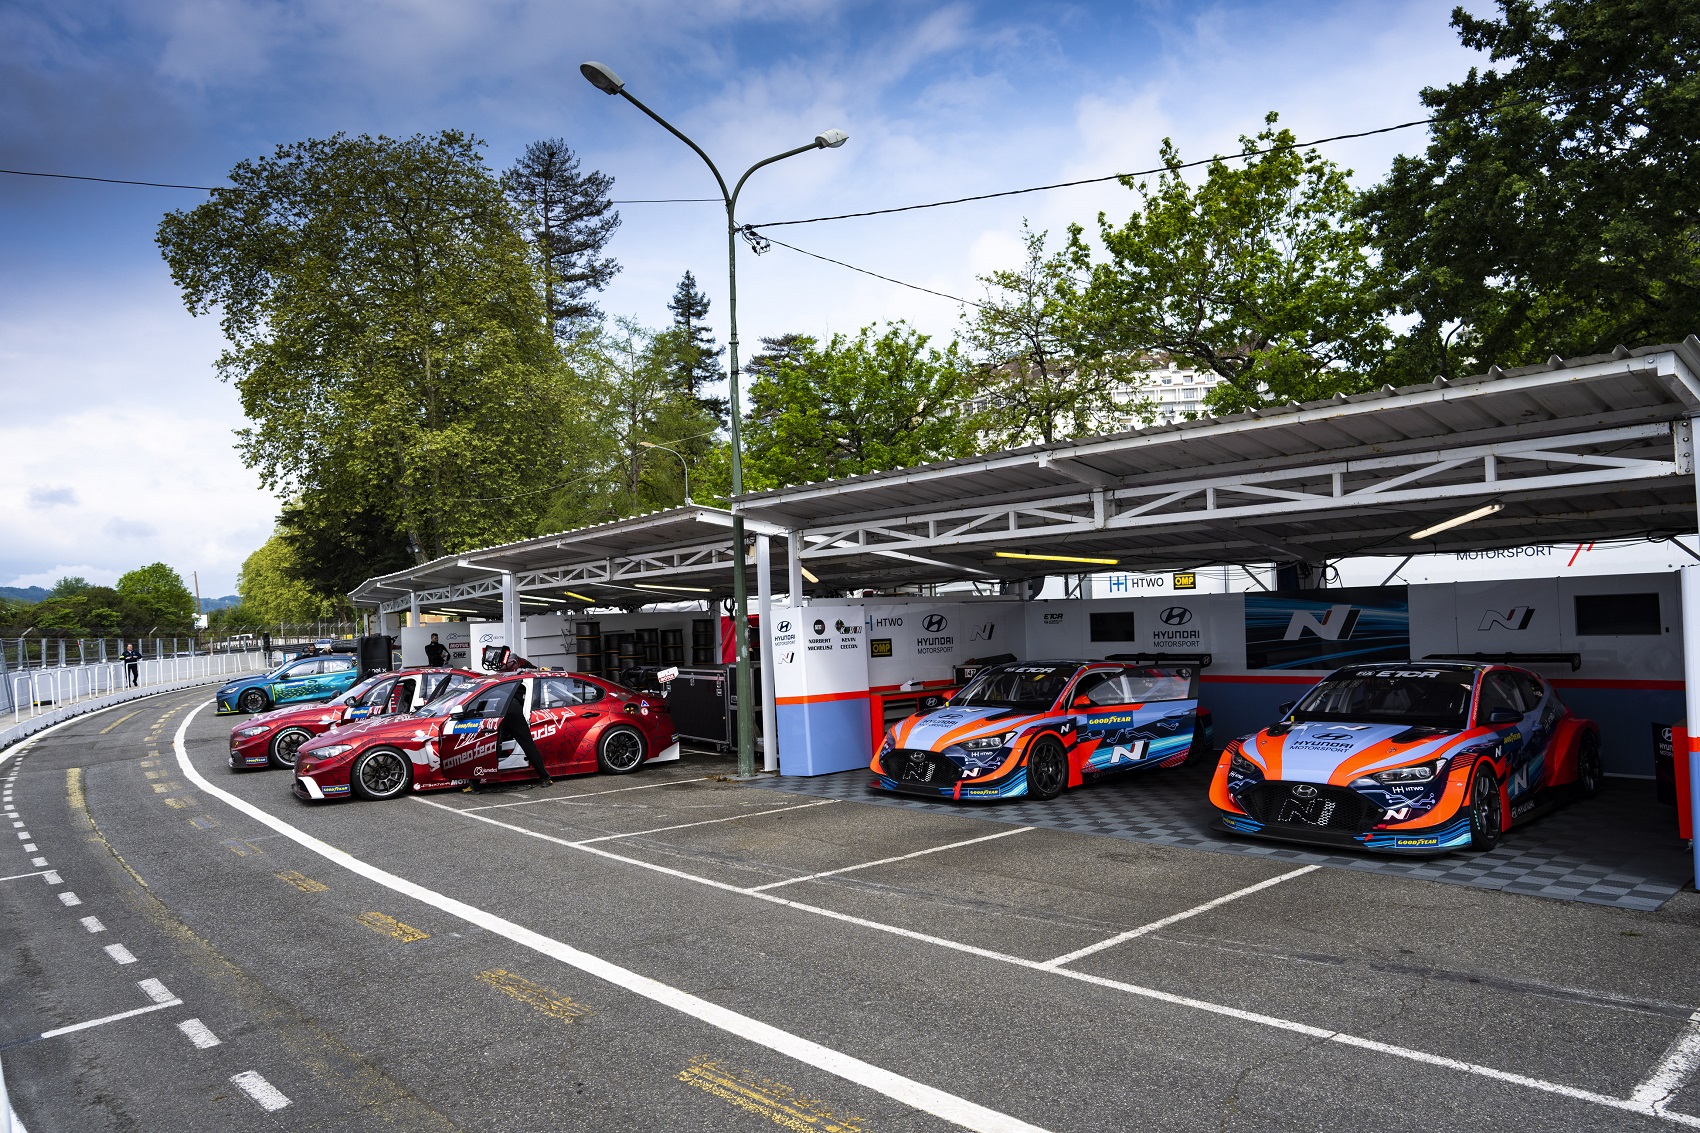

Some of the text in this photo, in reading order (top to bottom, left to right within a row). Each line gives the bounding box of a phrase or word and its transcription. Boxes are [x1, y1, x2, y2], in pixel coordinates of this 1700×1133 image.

[1456, 545, 1553, 561] MOTORSPORT
[1132, 577, 1164, 588] HTWO
[1174, 576, 1194, 585] OMP
[876, 618, 903, 627] HTWO
[774, 634, 796, 642] HYUNDAI
[1153, 630, 1200, 639] HYUNDAI
[917, 636, 954, 646] HYUNDAI
[872, 642, 891, 653] OMP
[1376, 670, 1440, 678] ETCR
[1089, 715, 1131, 725] GOODYEAR
[1290, 745, 1350, 753] MOTORSPORT
[969, 788, 999, 796] GOODYEAR
[1397, 838, 1437, 847] GOODYEAR
